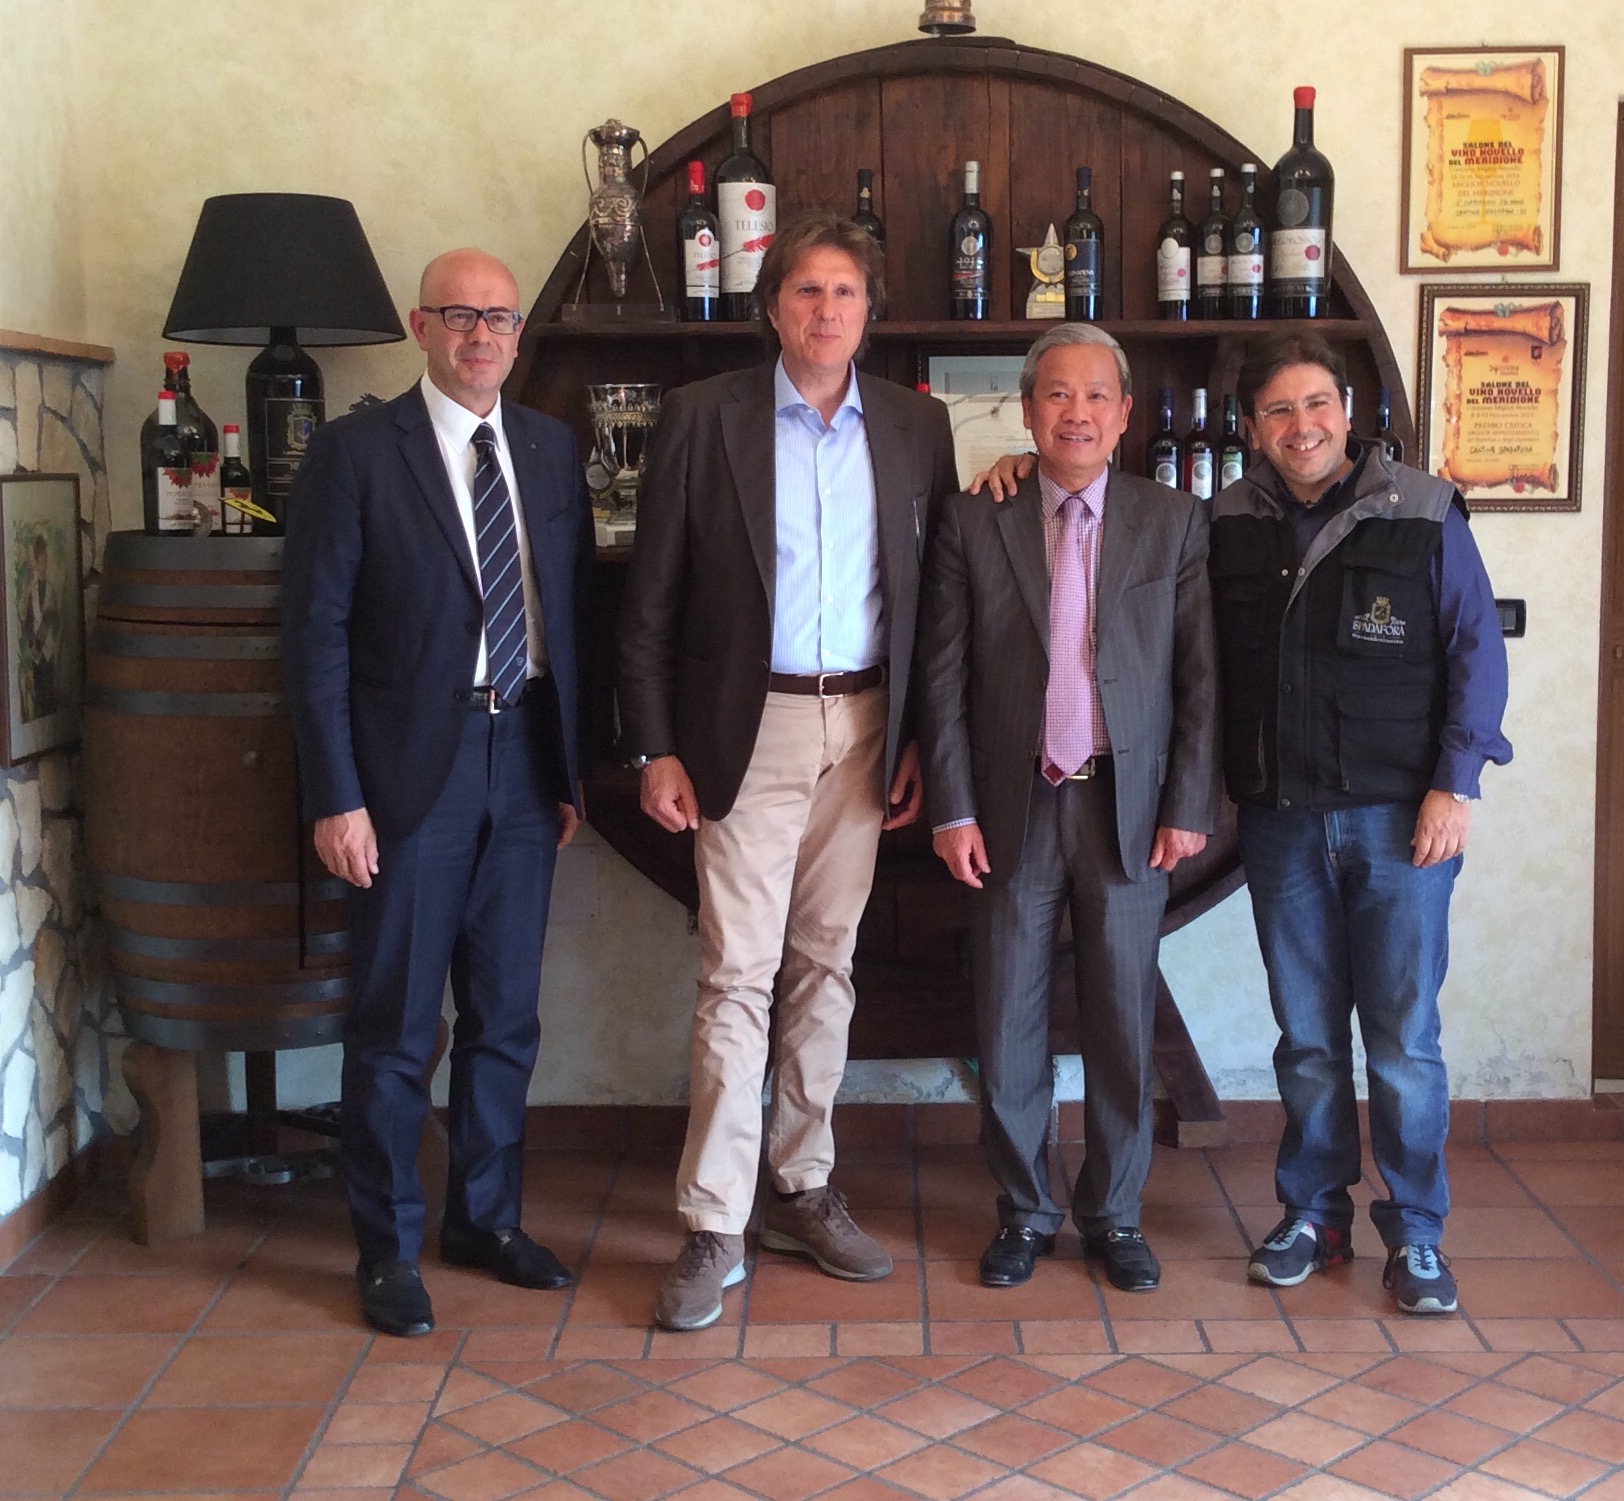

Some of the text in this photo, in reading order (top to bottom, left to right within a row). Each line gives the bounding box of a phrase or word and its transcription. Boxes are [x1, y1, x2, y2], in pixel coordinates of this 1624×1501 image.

[1462, 141, 1495, 149] SALONE
[1451, 147, 1525, 158] VINO NOVELLO
[1464, 156, 1523, 166] MERIDIONE
[1515, 380, 1531, 388] DEL
[1469, 388, 1542, 396] VINO NOVELLO
[1482, 395, 1540, 405] MERIDIONE
